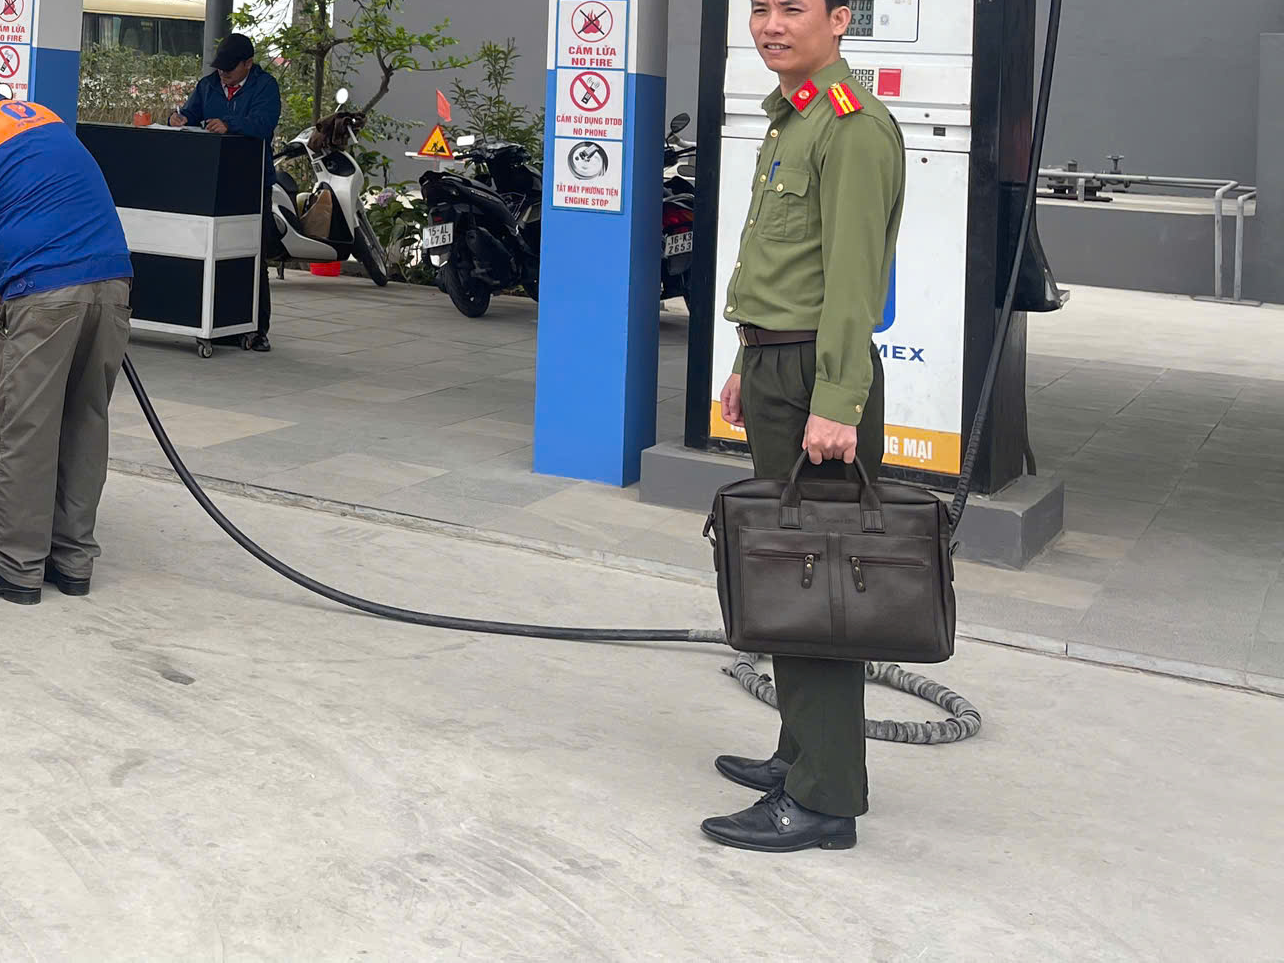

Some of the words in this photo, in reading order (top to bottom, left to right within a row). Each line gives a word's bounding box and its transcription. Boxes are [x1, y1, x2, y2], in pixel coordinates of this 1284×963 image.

[6, 35, 23, 43] FIRE
[568, 45, 593, 55] CẤM
[596, 45, 617, 56] LỬA
[571, 57, 586, 66] NO
[589, 58, 613, 67] FIRE
[573, 127, 583, 136] NO
[585, 128, 608, 138] PHONE
[564, 196, 589, 206] ENGINE
[591, 198, 609, 207] STOP
[903, 437, 932, 463] MẠI
